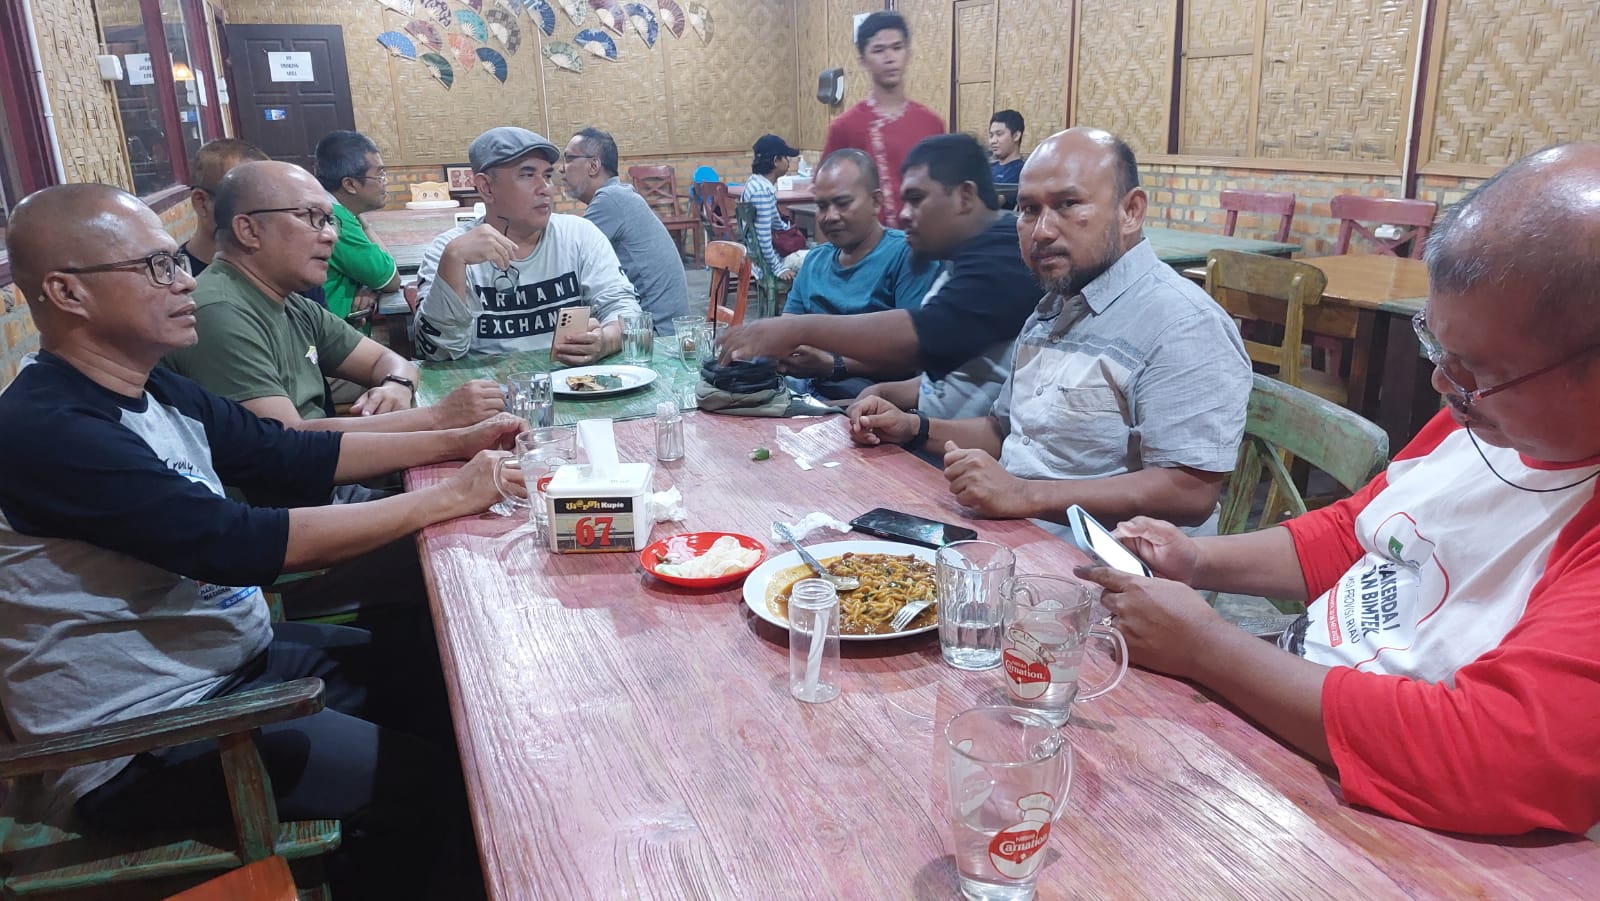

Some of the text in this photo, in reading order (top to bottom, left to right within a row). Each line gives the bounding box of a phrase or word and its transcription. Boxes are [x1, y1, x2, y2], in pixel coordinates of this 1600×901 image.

[480, 277, 576, 308] ARMANI
[480, 311, 562, 335] EXCHAN
[575, 516, 614, 547] 67
[1361, 592, 1380, 639] BIMTEK
[1345, 618, 1361, 645] RIAU
[1005, 659, 1047, 680] Carnation
[998, 833, 1049, 856] Carnation
